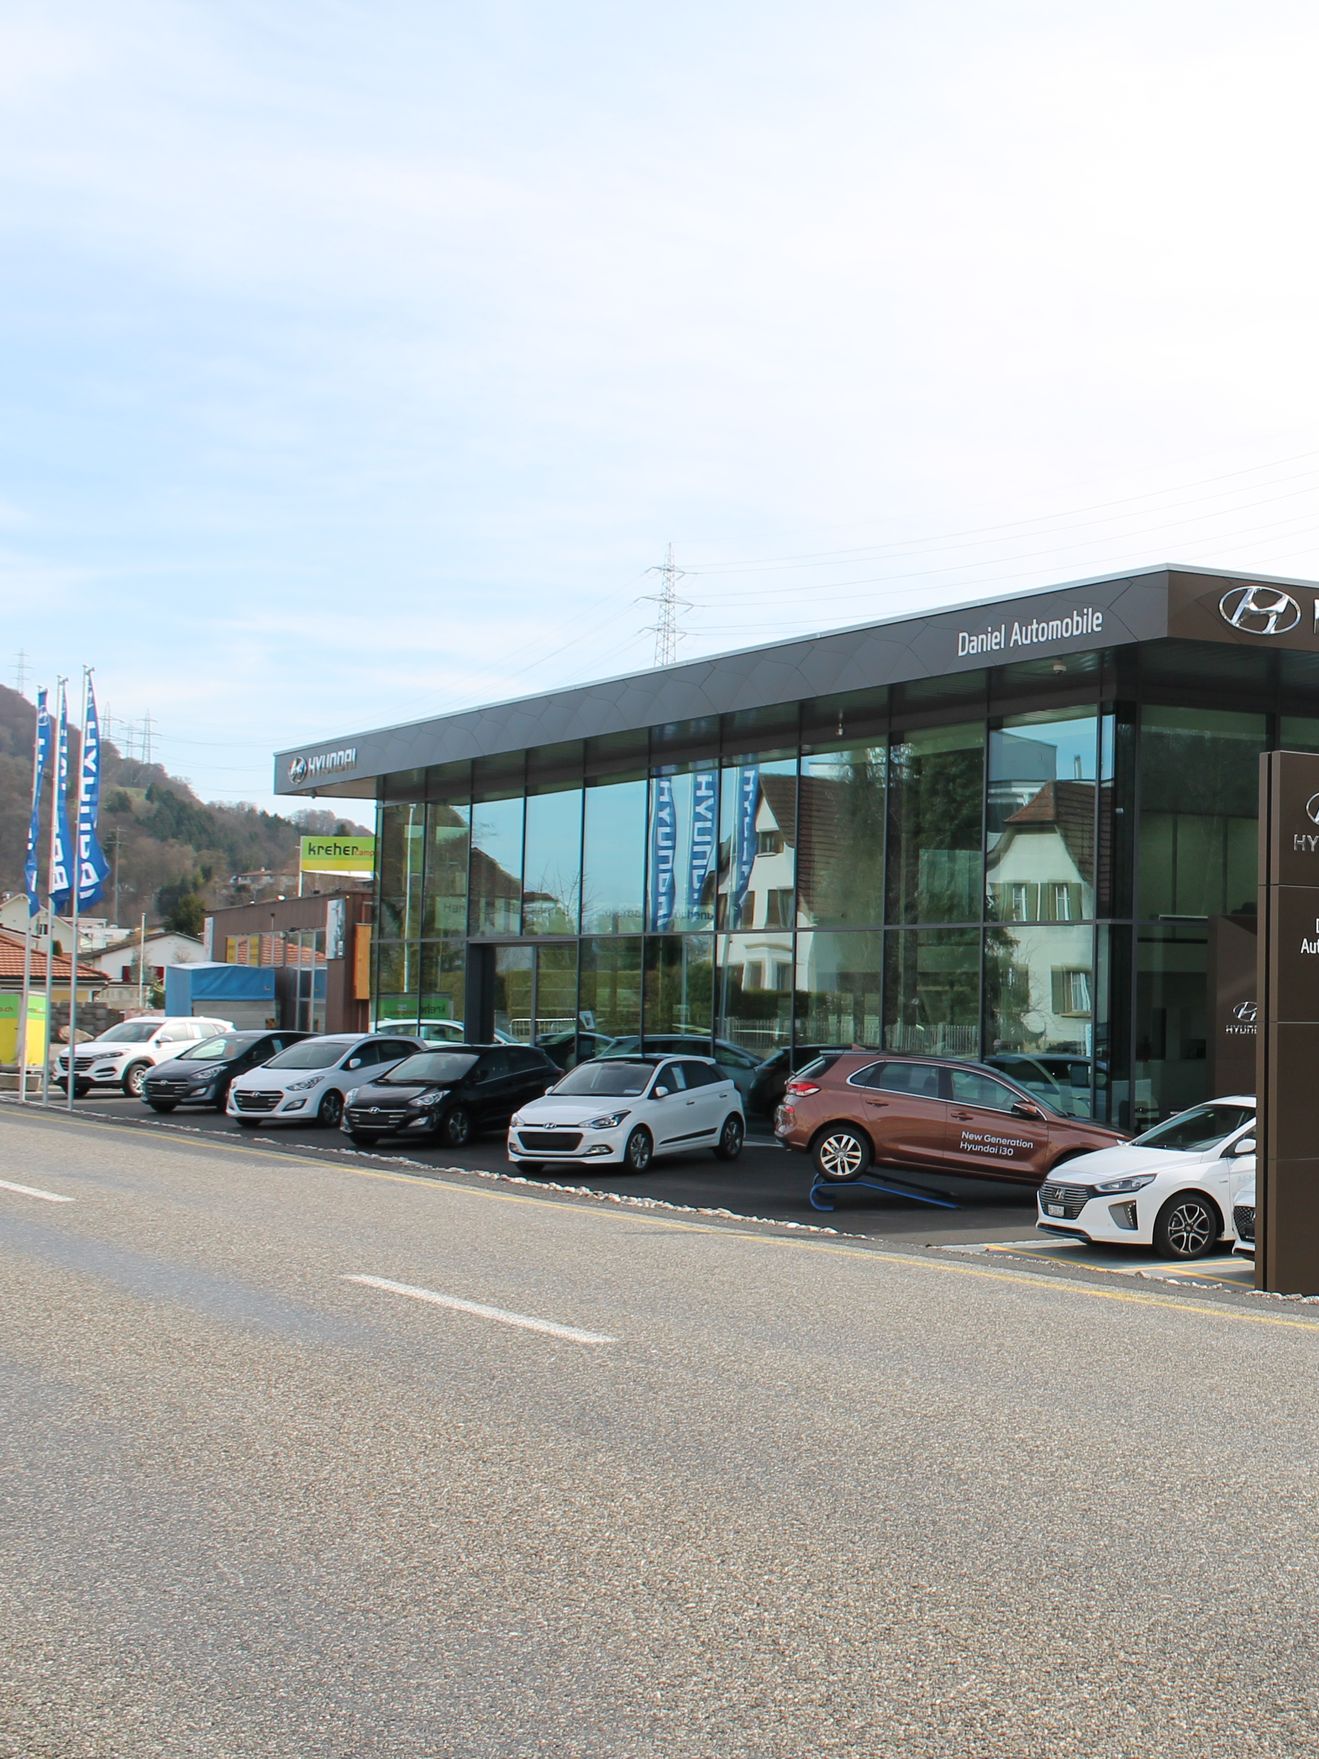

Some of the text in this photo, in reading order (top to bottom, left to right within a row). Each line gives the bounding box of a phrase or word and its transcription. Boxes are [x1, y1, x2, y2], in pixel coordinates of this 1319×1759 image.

[958, 608, 1103, 656] Daniel Automobile
[309, 748, 357, 774] HYUNDAI
[308, 843, 358, 856] kreher
[1225, 1025, 1257, 1034] HYUN
[961, 1131, 1034, 1149] New Generation
[960, 1141, 1014, 1156] Hyundai i30
